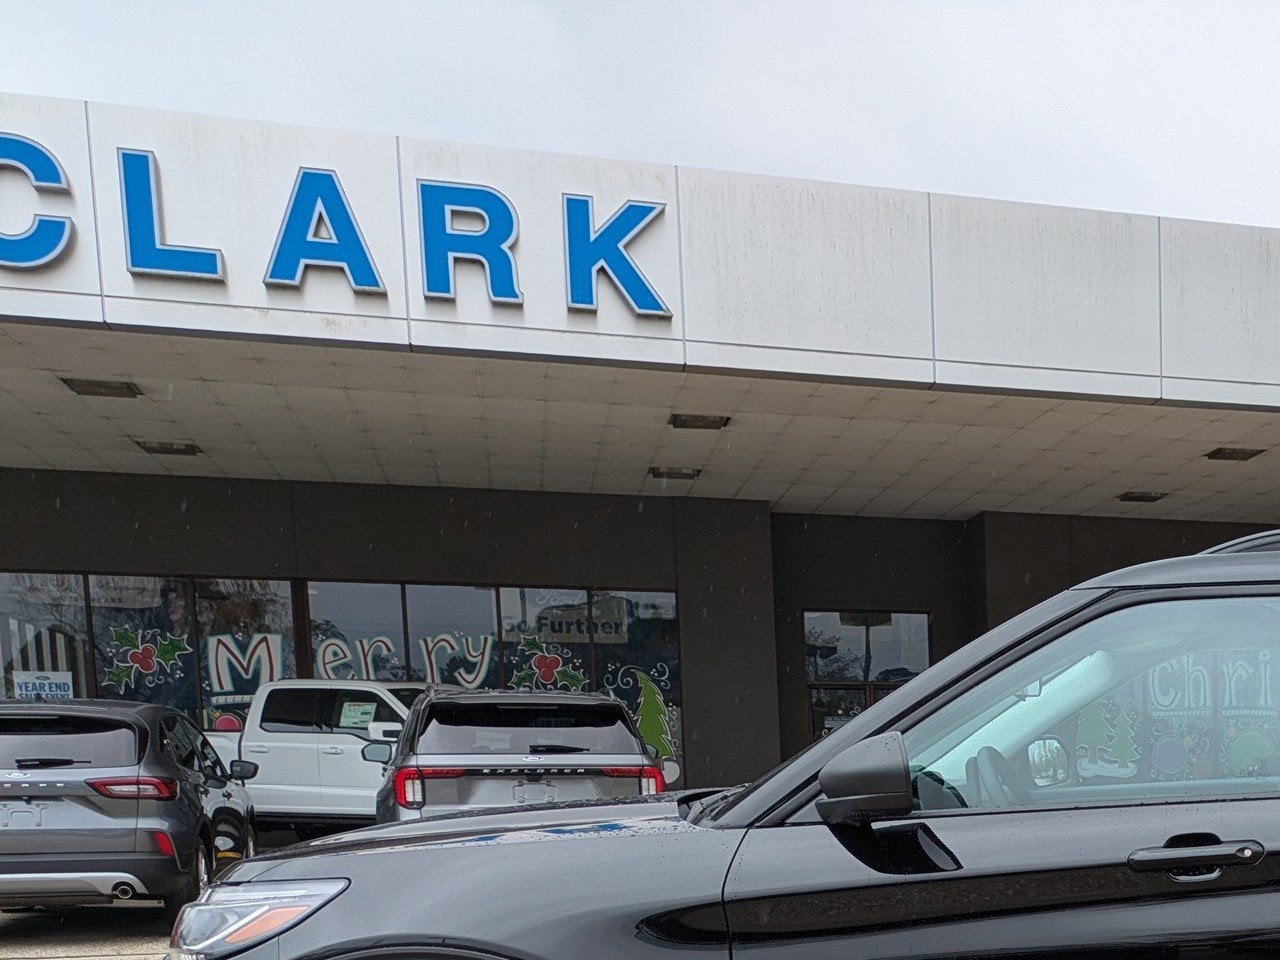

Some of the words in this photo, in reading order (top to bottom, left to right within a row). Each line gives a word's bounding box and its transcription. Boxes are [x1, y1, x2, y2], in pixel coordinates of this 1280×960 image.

[0, 131, 673, 317] CLARK
[537, 615, 622, 634] Further
[207, 632, 494, 693] Merry
[17, 682, 46, 693] YEAR
[48, 682, 70, 693] END
